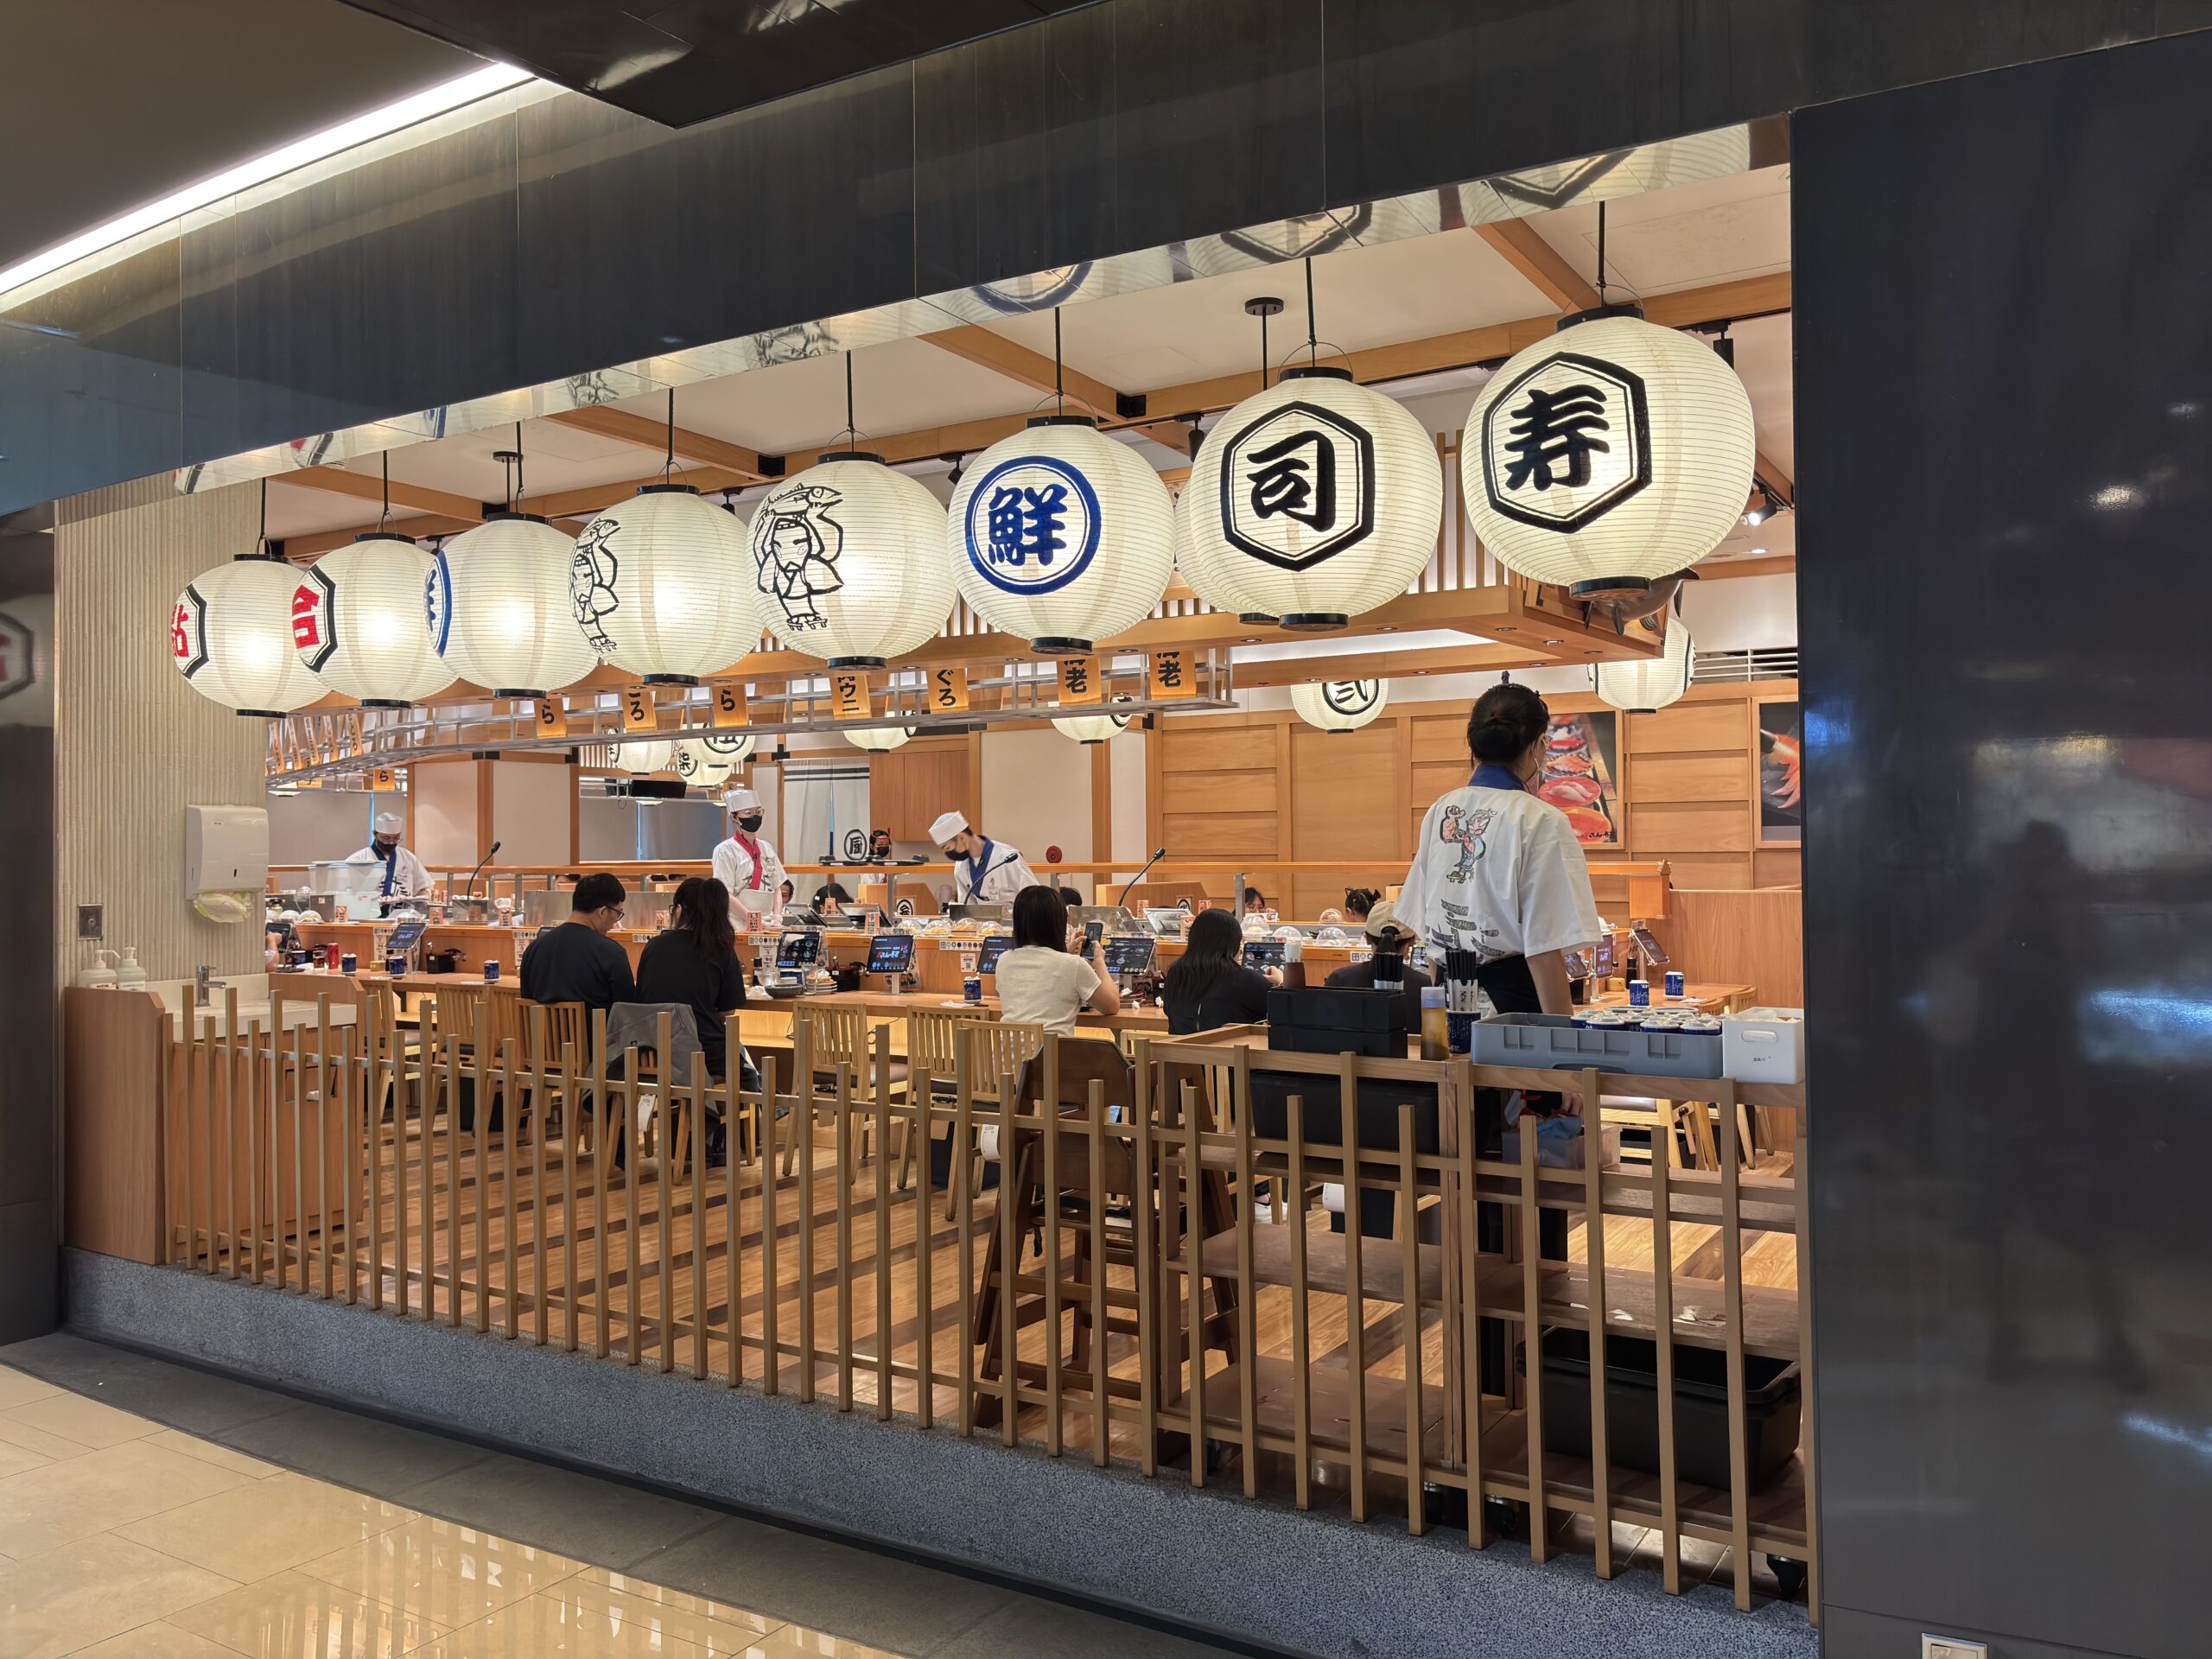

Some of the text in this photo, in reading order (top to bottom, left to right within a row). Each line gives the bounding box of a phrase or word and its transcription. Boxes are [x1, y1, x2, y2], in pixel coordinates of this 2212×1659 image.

[1503, 385, 1611, 491] 寿
[1247, 430, 1336, 531] 司
[988, 484, 1067, 567] 鮮
[1064, 658, 1088, 694] 老
[1156, 651, 1182, 688] 老
[542, 699, 555, 725] ら
[721, 685, 735, 711] ら
